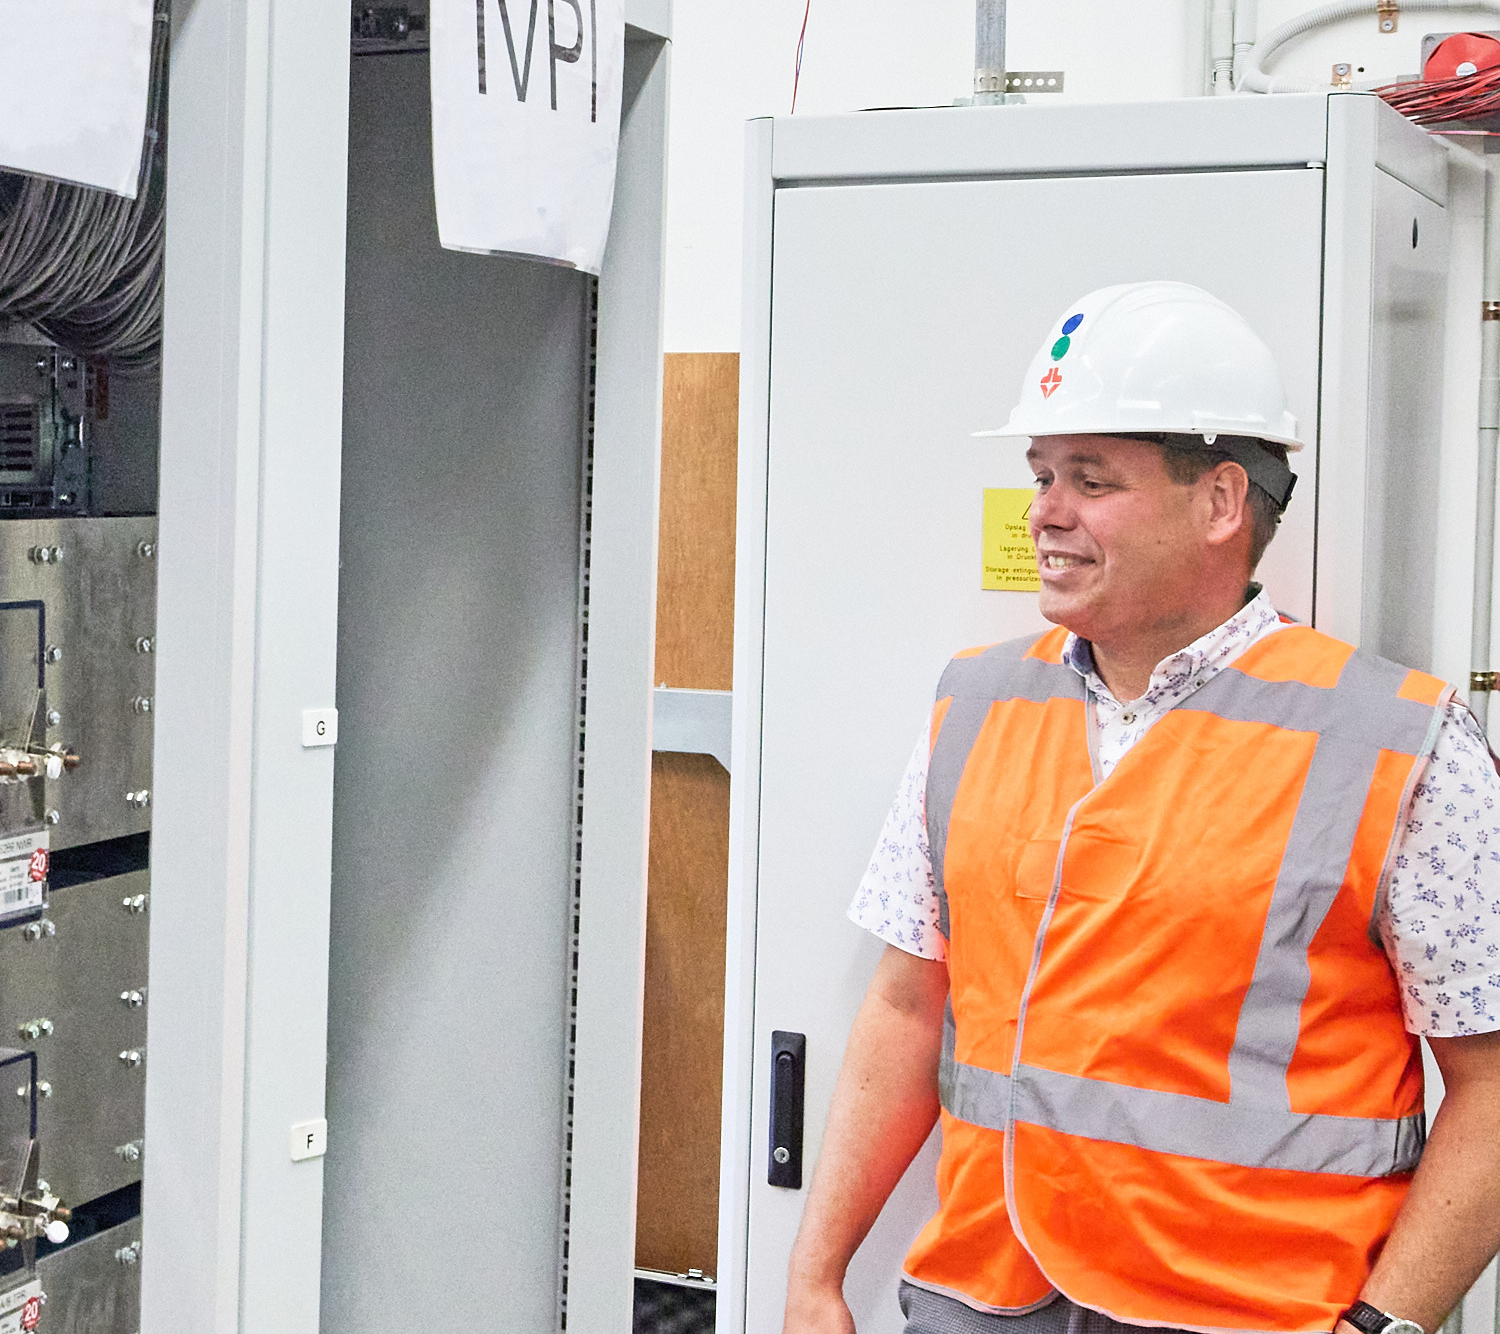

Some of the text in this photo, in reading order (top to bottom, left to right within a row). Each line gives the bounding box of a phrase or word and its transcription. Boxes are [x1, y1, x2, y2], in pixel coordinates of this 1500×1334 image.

[1005, 523, 1026, 531] Opslag
[999, 545, 1029, 553] Lagerung
[985, 565, 1009, 573] Storage
[316, 720, 326, 736] G
[31, 853, 47, 873] 20
[307, 1133, 314, 1149] F
[23, 1302, 39, 1322] 20
